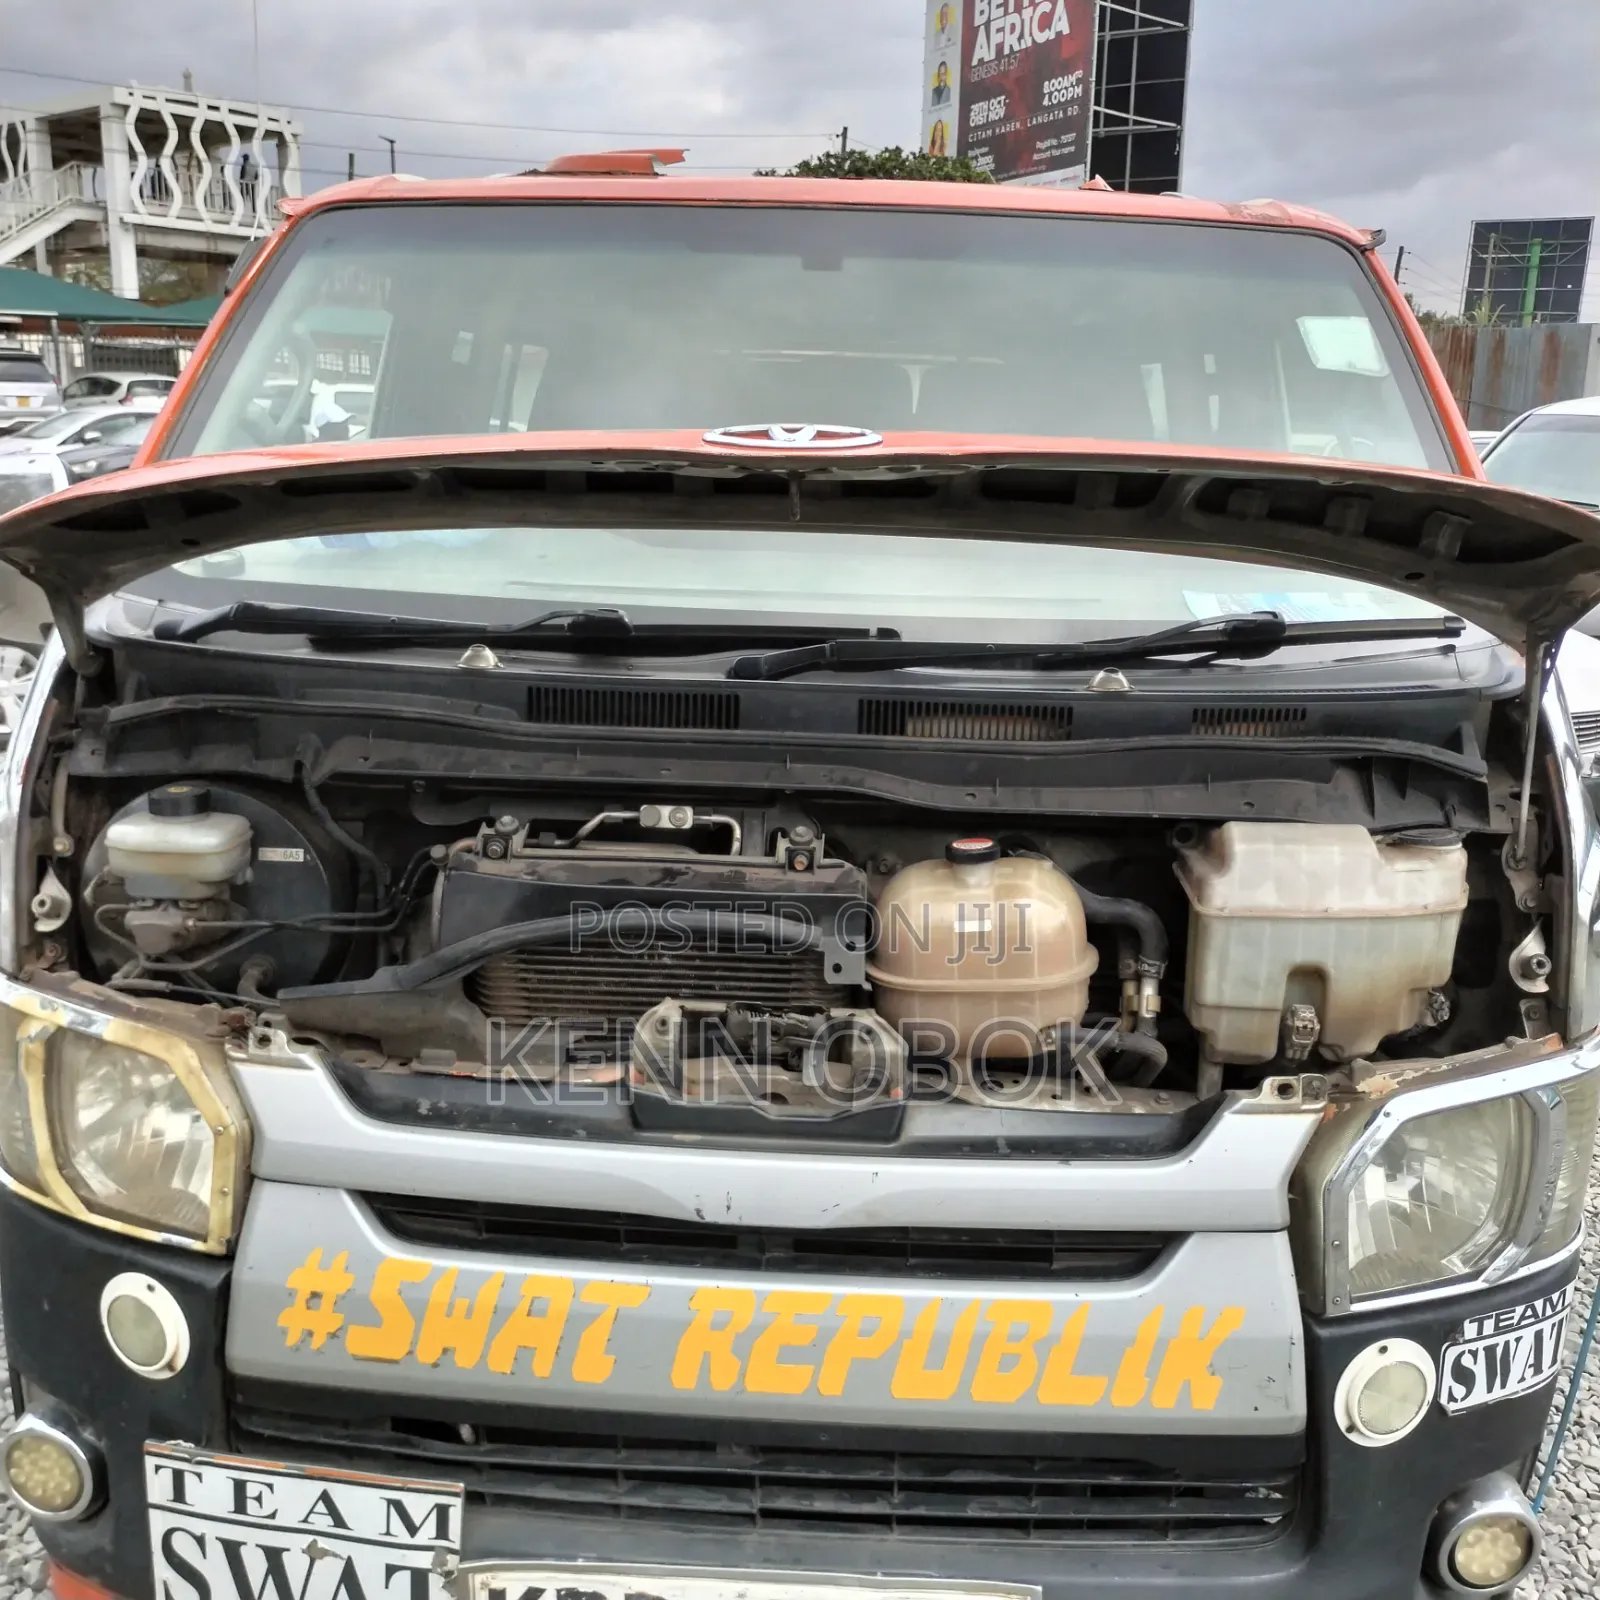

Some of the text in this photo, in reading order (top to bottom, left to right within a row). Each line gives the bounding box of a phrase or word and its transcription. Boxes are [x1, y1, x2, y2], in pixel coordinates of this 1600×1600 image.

[971, 0, 1070, 67] AFRICA
[988, 106, 1006, 122] NOV
[1042, 84, 1083, 107] 4.00PM
[968, 130, 993, 143] CITAM
[1027, 109, 1064, 128] LANGATA
[277, 1247, 1246, 1410] #SWAT REPUBLIK
[1469, 1287, 1568, 1337] TEAM
[1446, 1312, 1569, 1405] SWAT
[154, 1463, 457, 1543] TEAM
